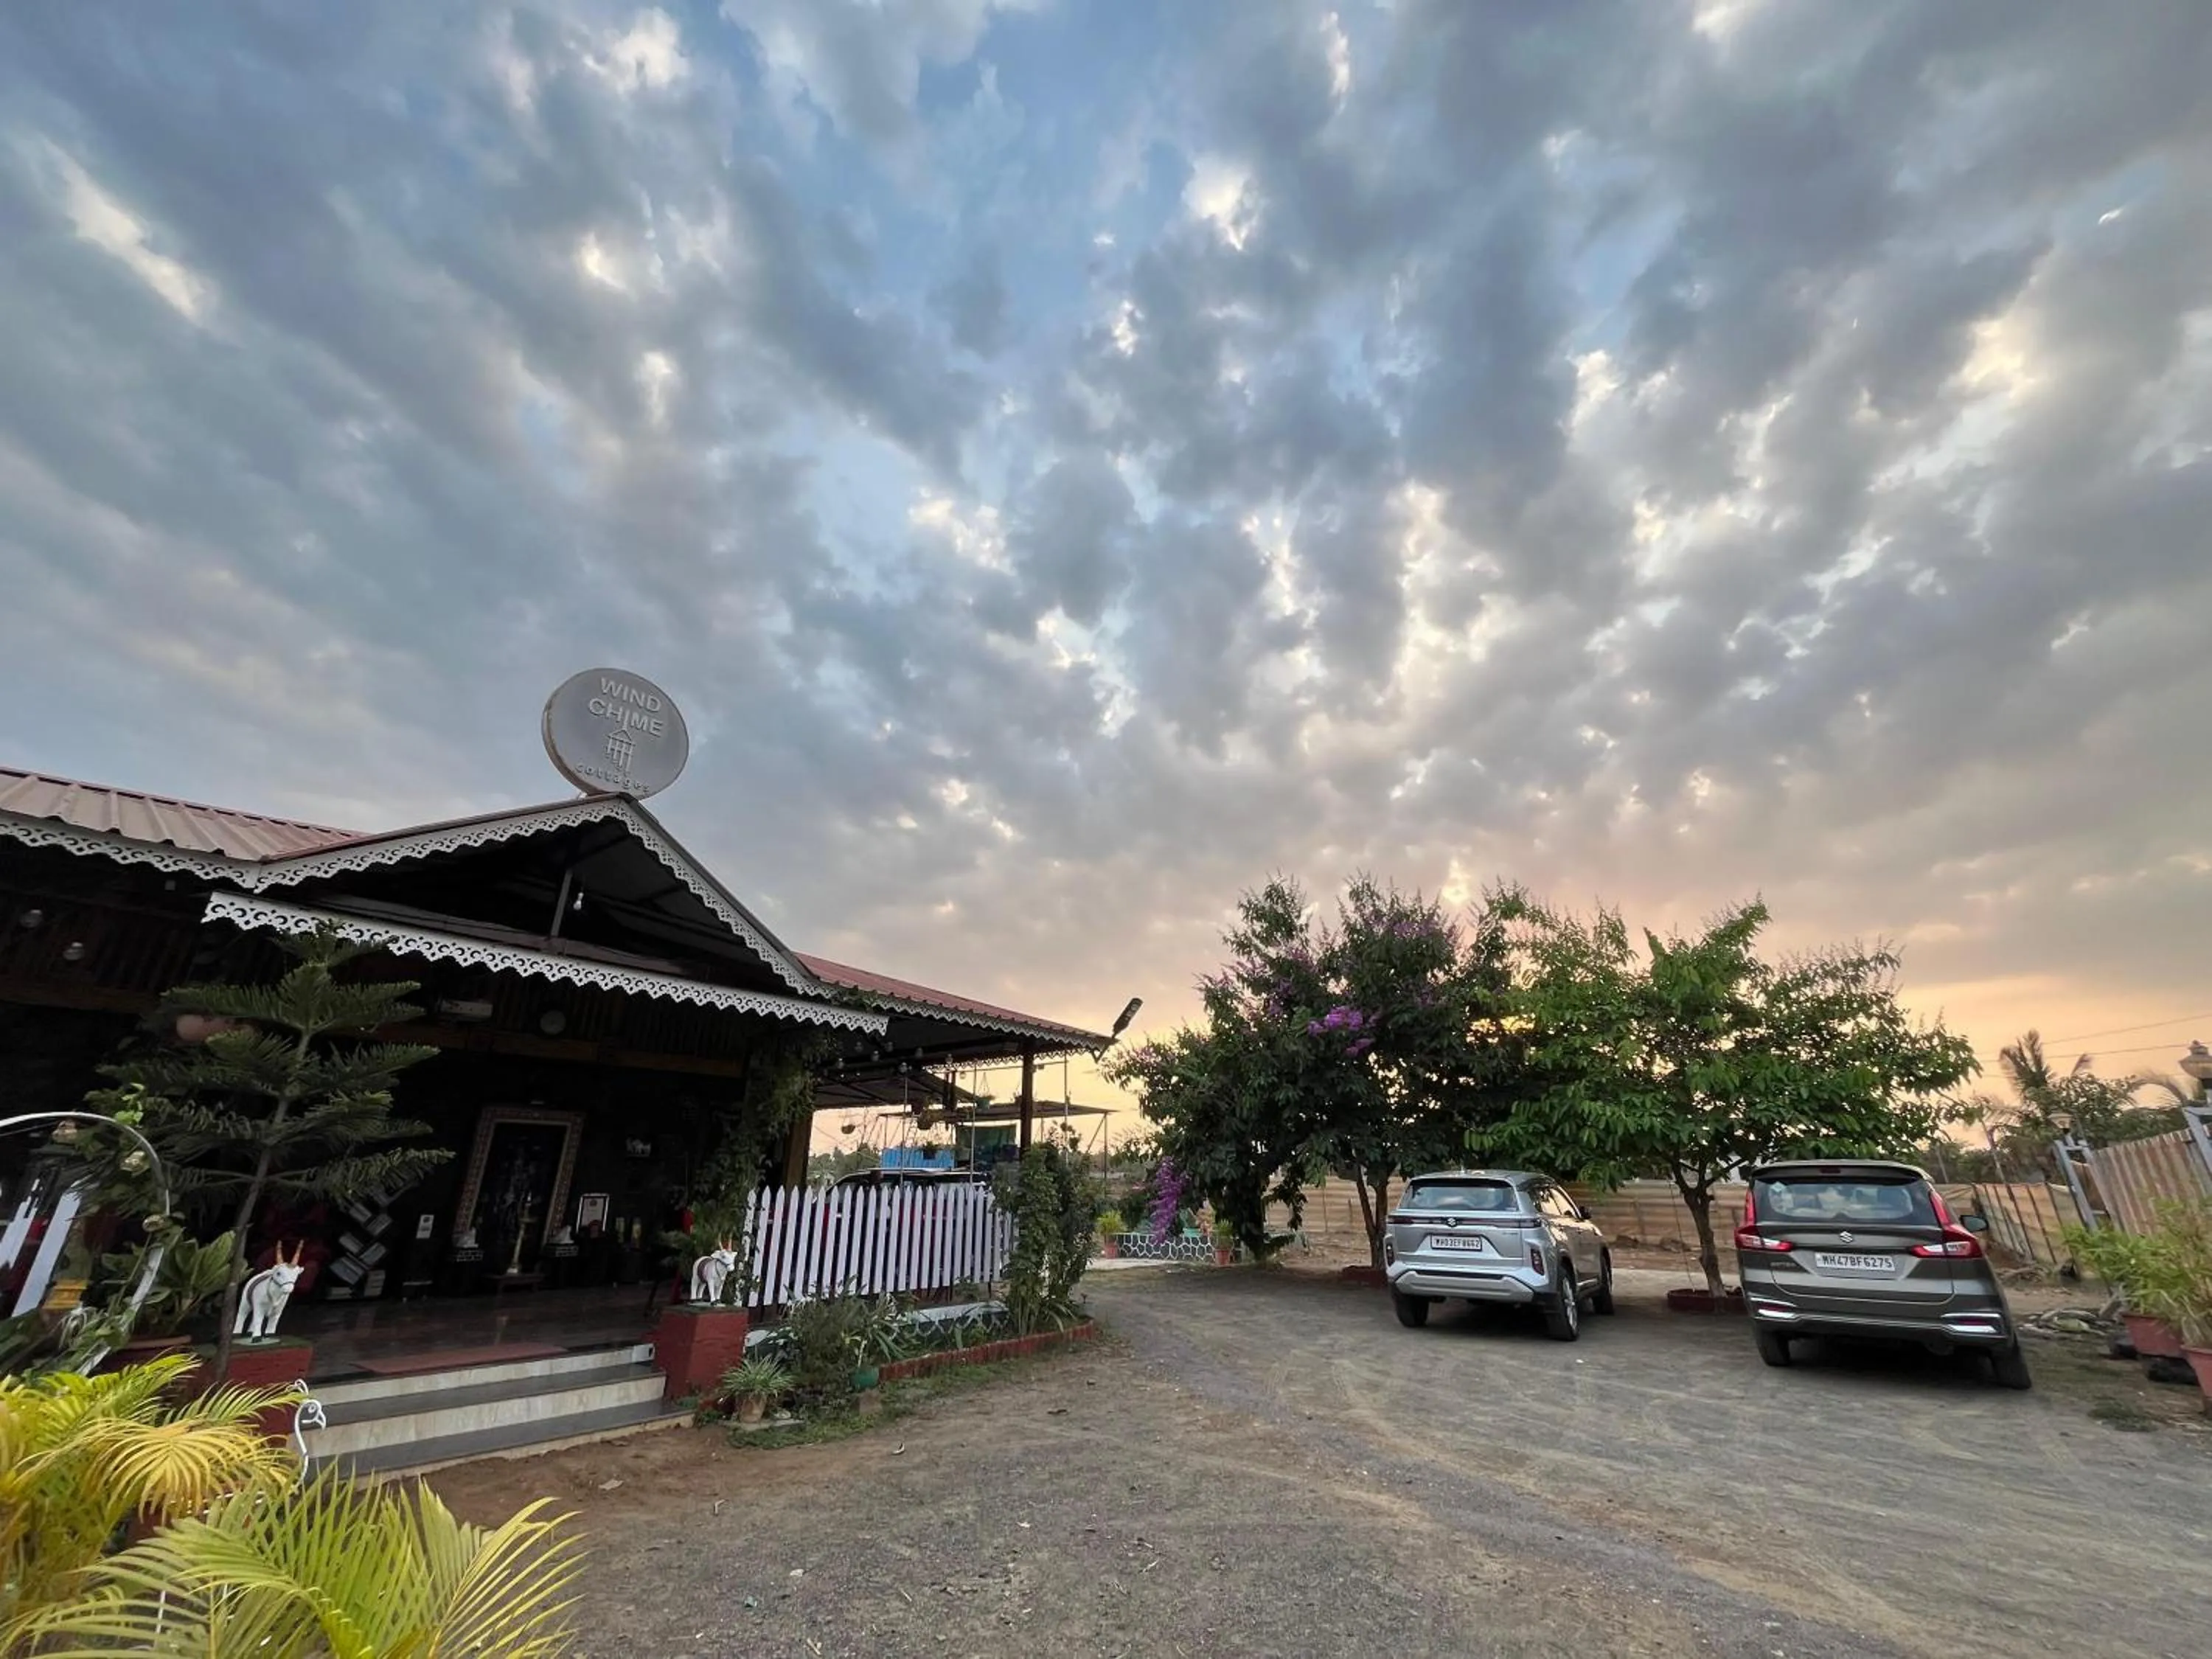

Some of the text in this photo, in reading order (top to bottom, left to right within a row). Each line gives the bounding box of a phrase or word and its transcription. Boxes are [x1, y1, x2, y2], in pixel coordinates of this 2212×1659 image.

[600, 677, 661, 713] WIND
[588, 698, 664, 737] CHIME
[1822, 1255, 1893, 1268] MH47BF6275
